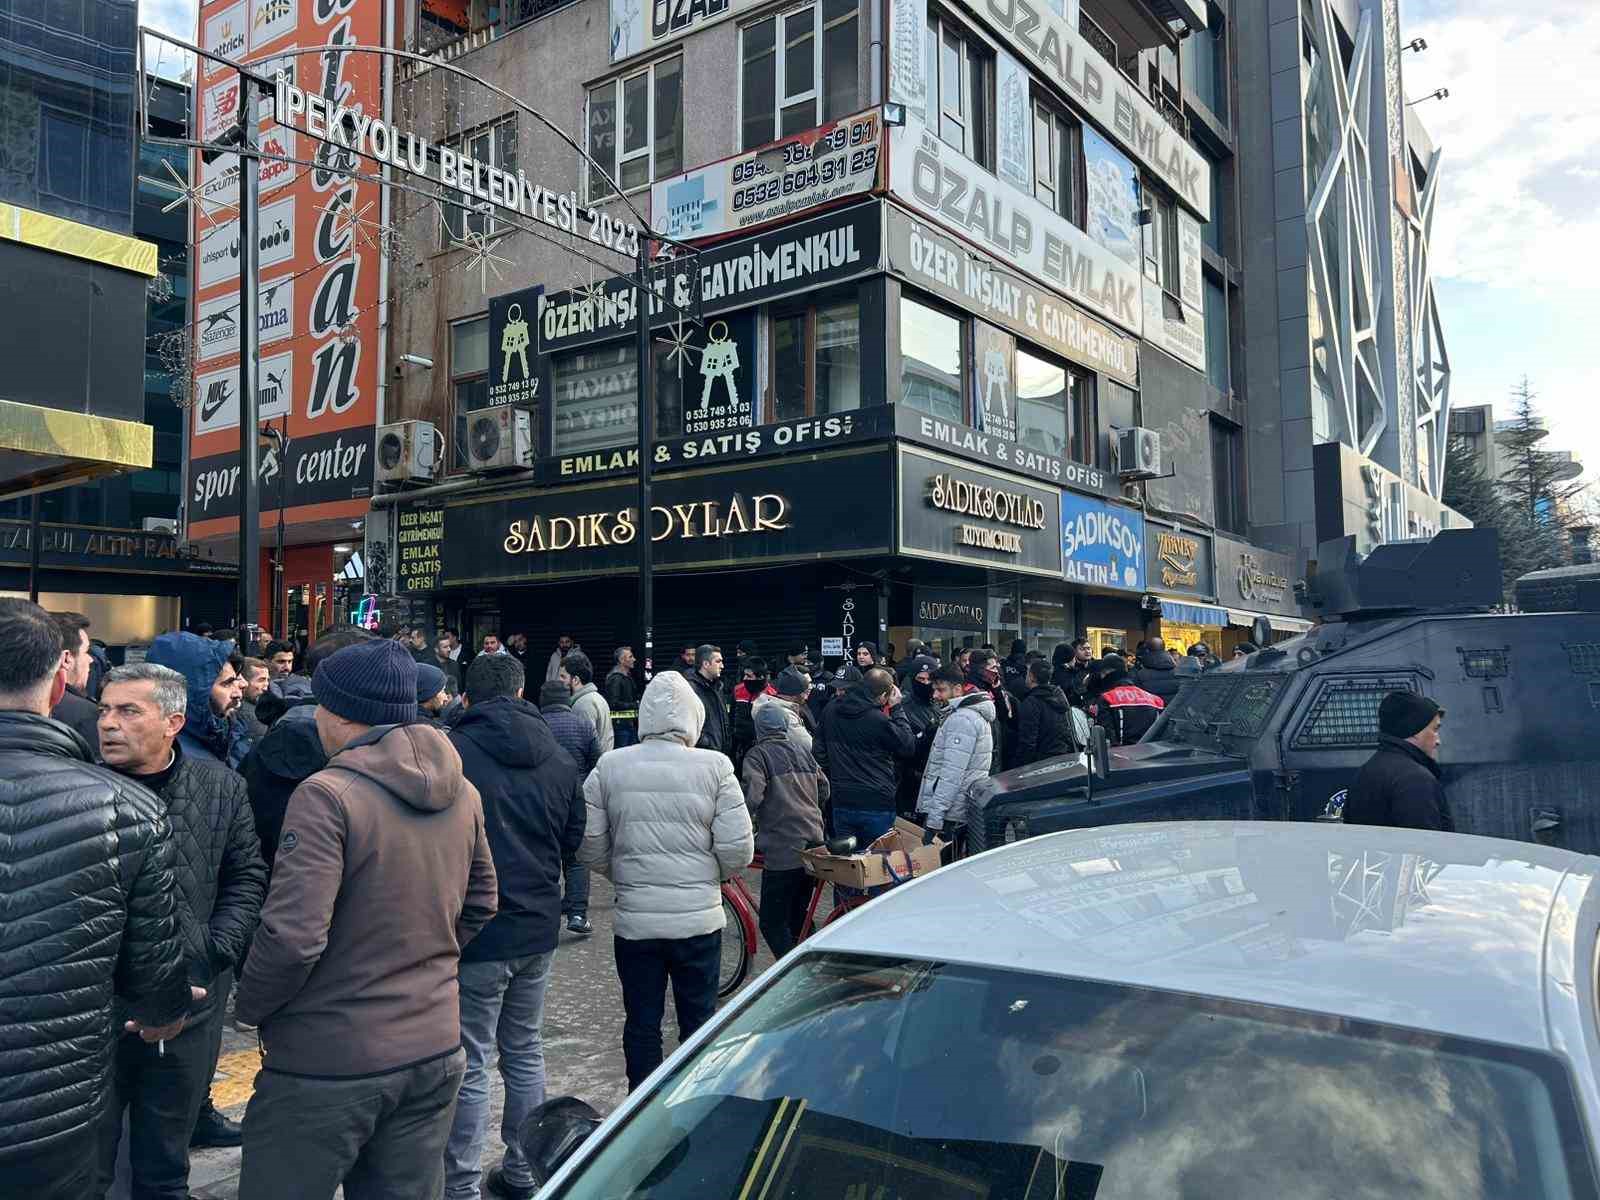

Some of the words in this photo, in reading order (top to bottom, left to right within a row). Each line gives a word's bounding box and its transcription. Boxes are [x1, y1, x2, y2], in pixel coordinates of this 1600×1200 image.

[1113, 88, 1201, 206] EMLAK
[439, 144, 578, 235] BELEDİYESİ
[587, 207, 640, 259] 2023
[732, 177, 781, 212] 0532
[781, 162, 820, 196] 604
[821, 153, 848, 182] 31
[849, 144, 878, 174] 23
[912, 132, 1033, 258] ÖZALP
[1041, 229, 1139, 326] EMLAK
[544, 294, 596, 342] ÖZER
[673, 272, 692, 309] &
[701, 223, 861, 302] GAYRİMENKUL
[910, 222, 960, 292] ÖZER
[963, 252, 1022, 323] İNŞAAT
[1024, 294, 1040, 331] &
[206, 378, 230, 404] NIKE
[686, 410, 692, 421] 0
[693, 408, 709, 420] 532
[710, 405, 725, 418] 749
[727, 403, 738, 415] 13
[739, 401, 750, 413] 03
[559, 448, 641, 476] EMLAK
[653, 444, 672, 463] &
[682, 431, 763, 455] SATIŞ
[686, 423, 692, 433] 0
[693, 421, 708, 432] 530
[709, 418, 725, 430] 935
[727, 417, 738, 428] 25
[920, 415, 990, 457] EMLAK
[996, 442, 1009, 462] &
[1015, 448, 1061, 481] SATIŞ
[194, 465, 241, 512] spor
[295, 436, 368, 486] center
[931, 473, 1047, 531] SADIKSOYLAR
[402, 544, 440, 560] EMLAK
[1064, 511, 1142, 569] SADIKSOY
[400, 563, 408, 576] &
[1066, 559, 1108, 585] ALTIN
